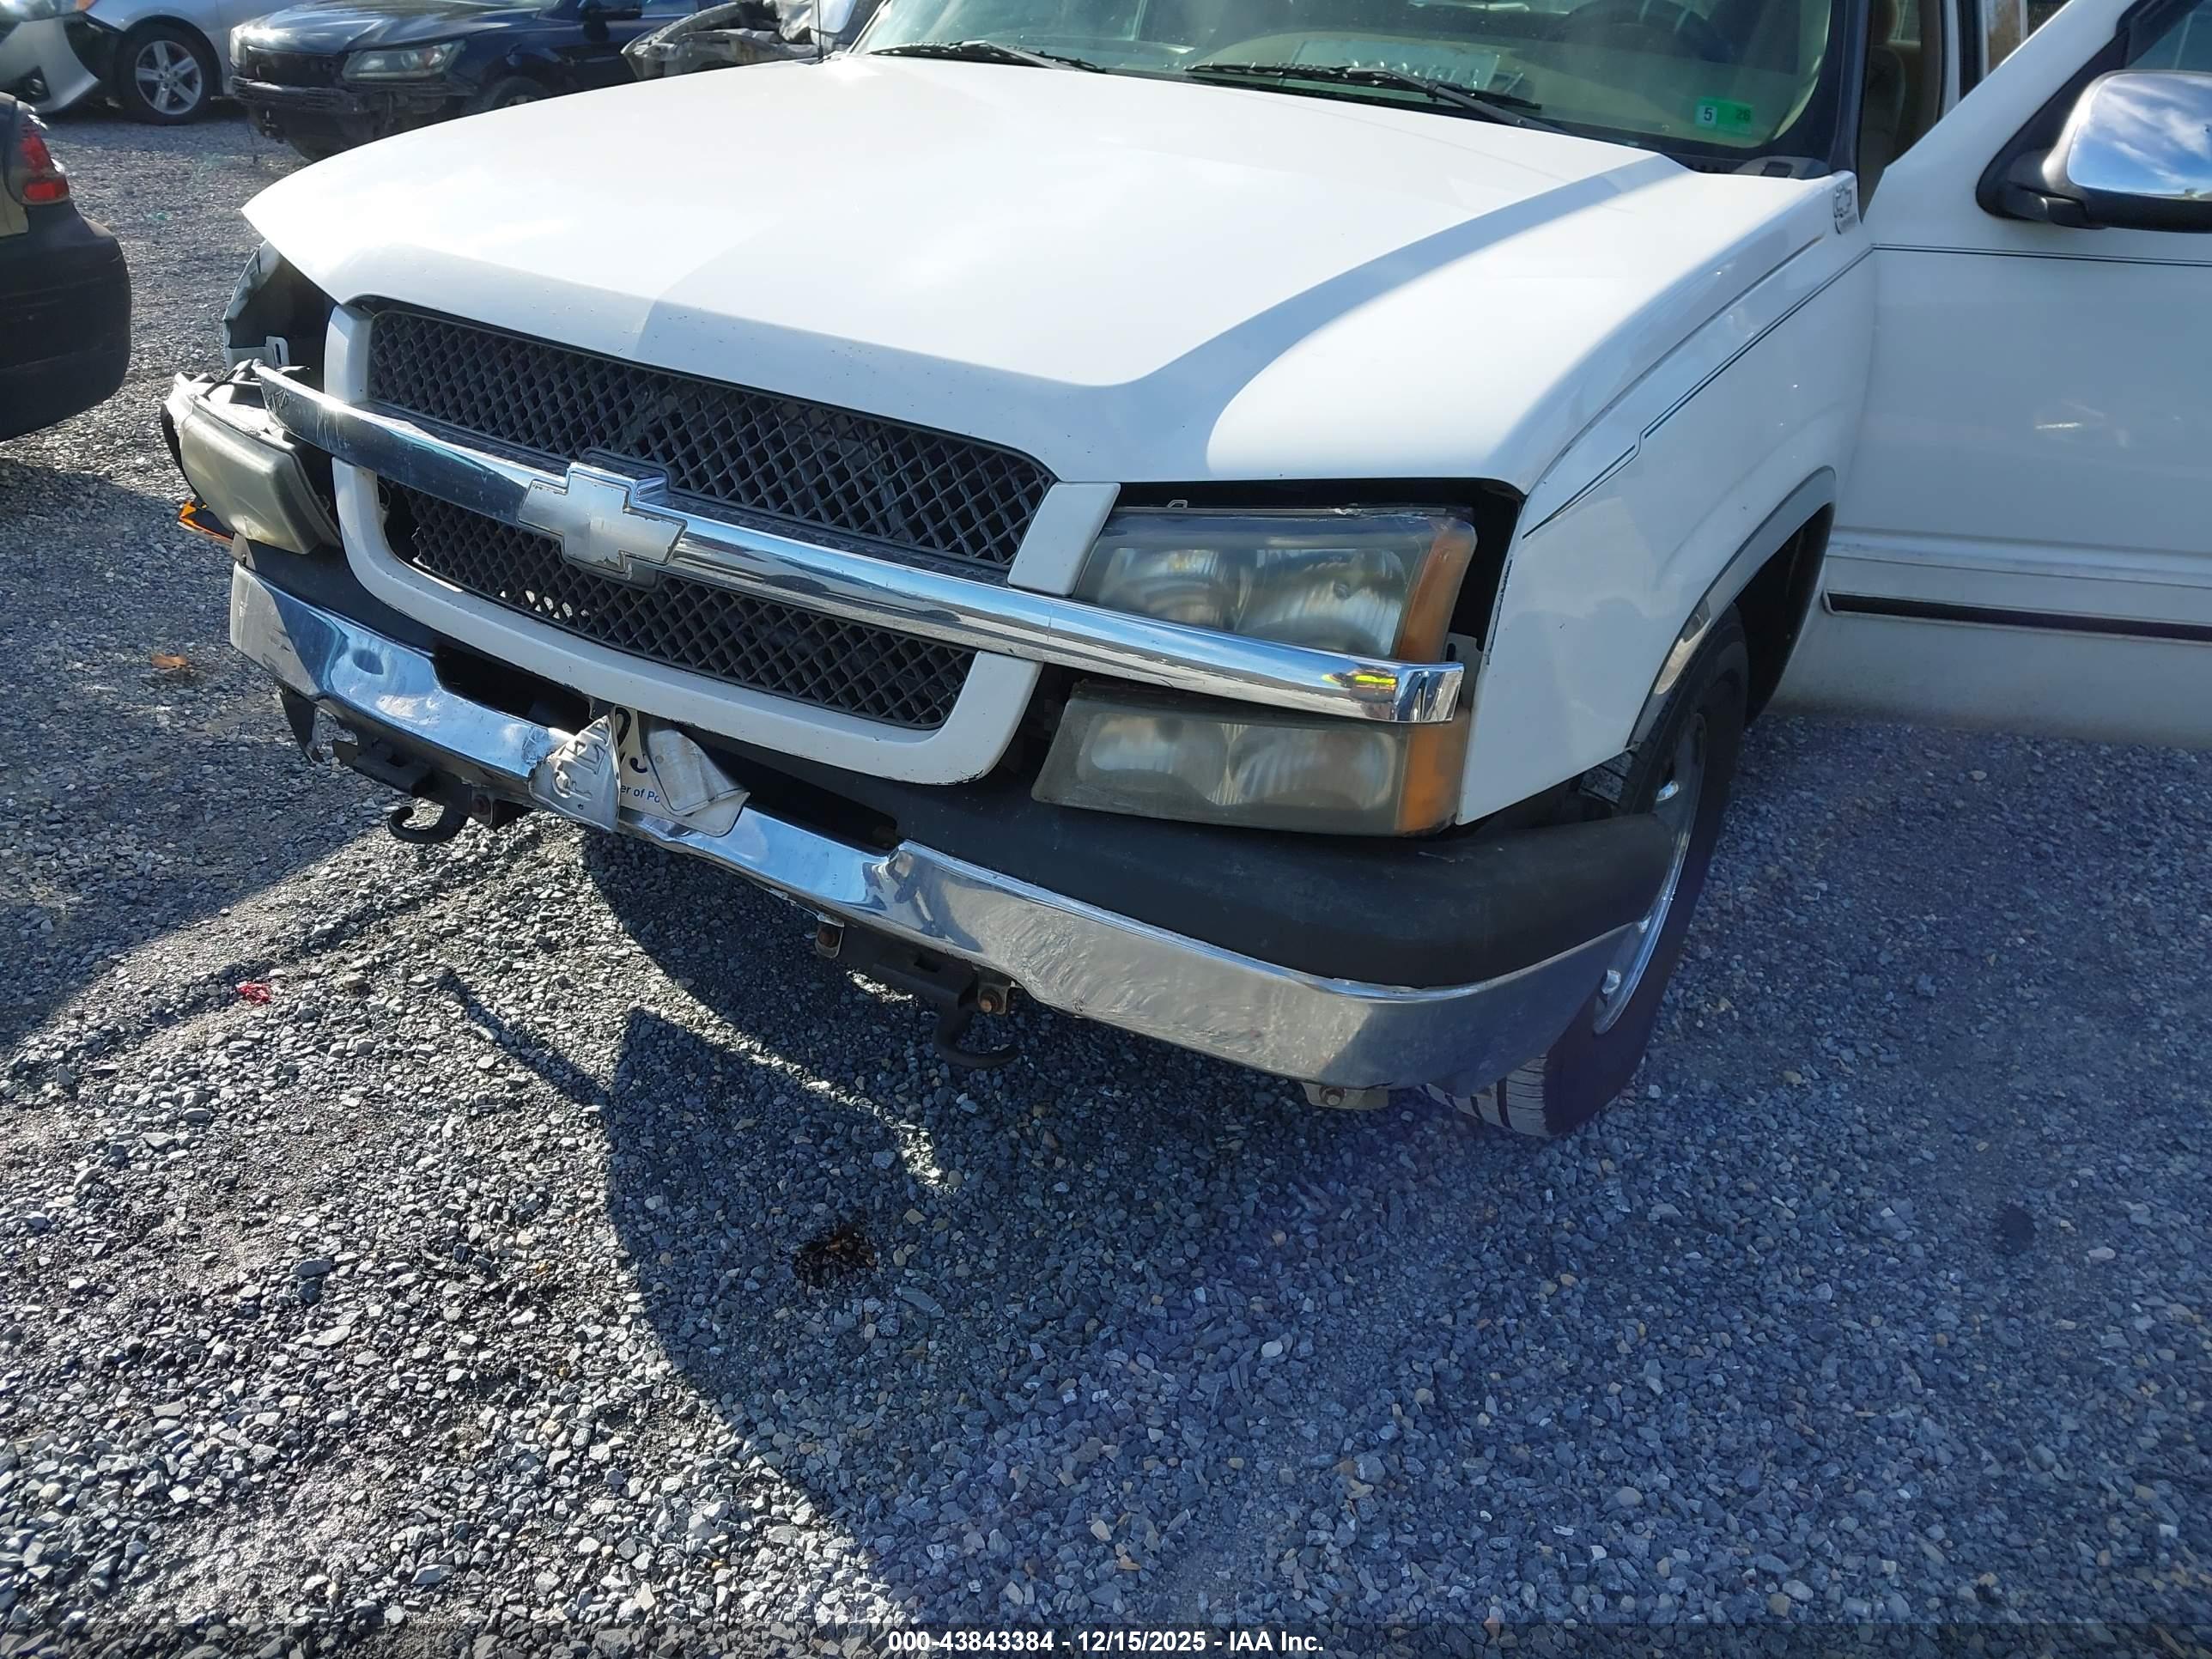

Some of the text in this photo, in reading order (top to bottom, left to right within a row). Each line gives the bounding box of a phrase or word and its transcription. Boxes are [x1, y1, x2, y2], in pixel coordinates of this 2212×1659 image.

[1704, 107, 1751, 122] 5 26
[634, 788, 645, 798] of
